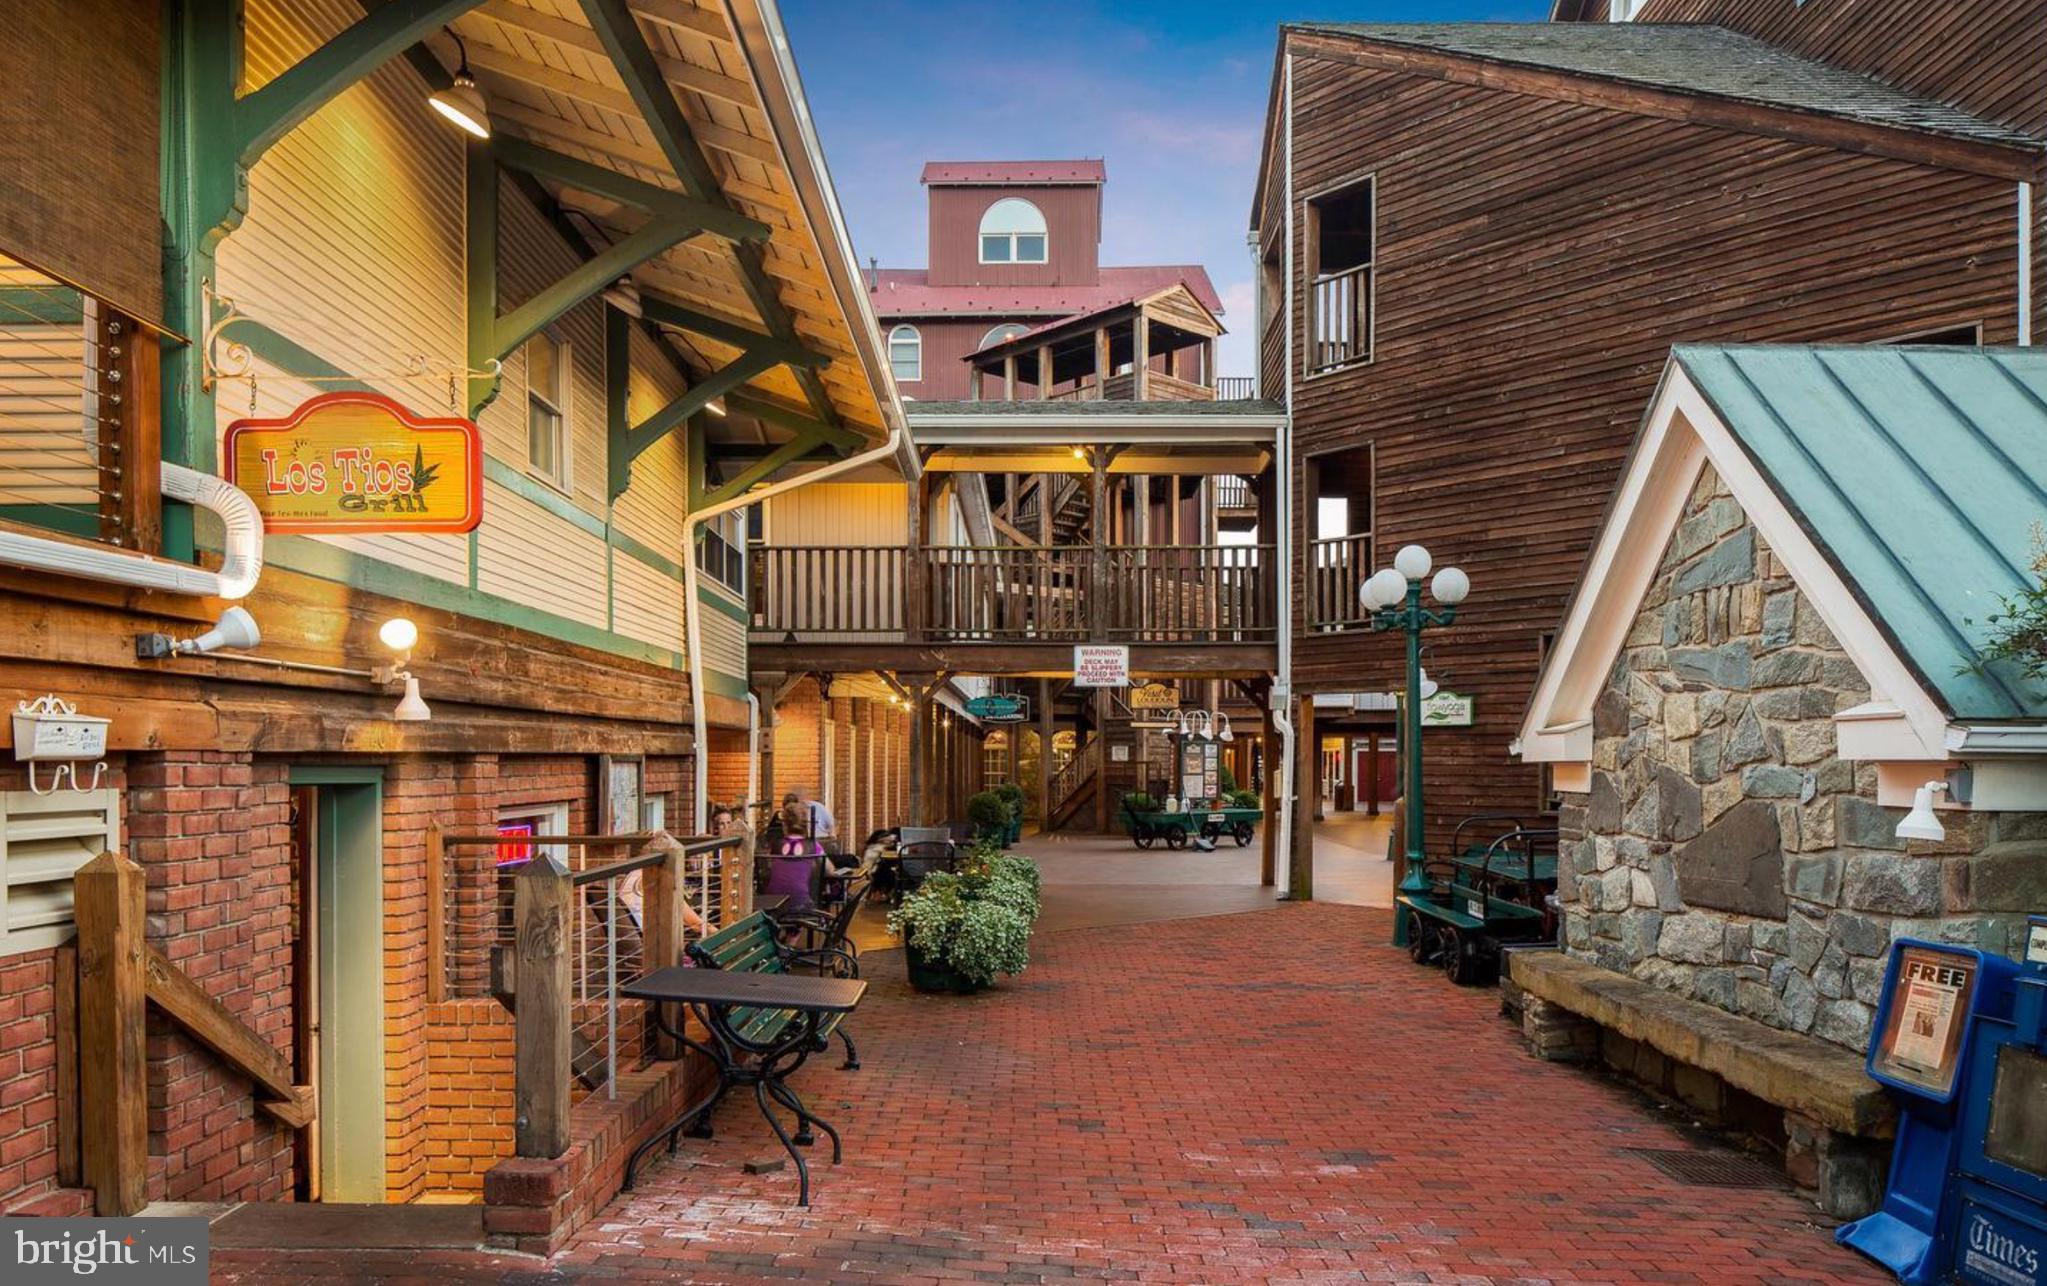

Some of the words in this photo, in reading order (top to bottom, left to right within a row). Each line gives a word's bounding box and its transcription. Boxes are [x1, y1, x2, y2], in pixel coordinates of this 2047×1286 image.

[261, 448, 328, 495] Los
[333, 447, 415, 495] Tios
[338, 493, 428, 513] Grill
[1081, 648, 1122, 656] WARNING
[1907, 963, 1966, 988] FREE
[1969, 1214, 2039, 1274] Times
